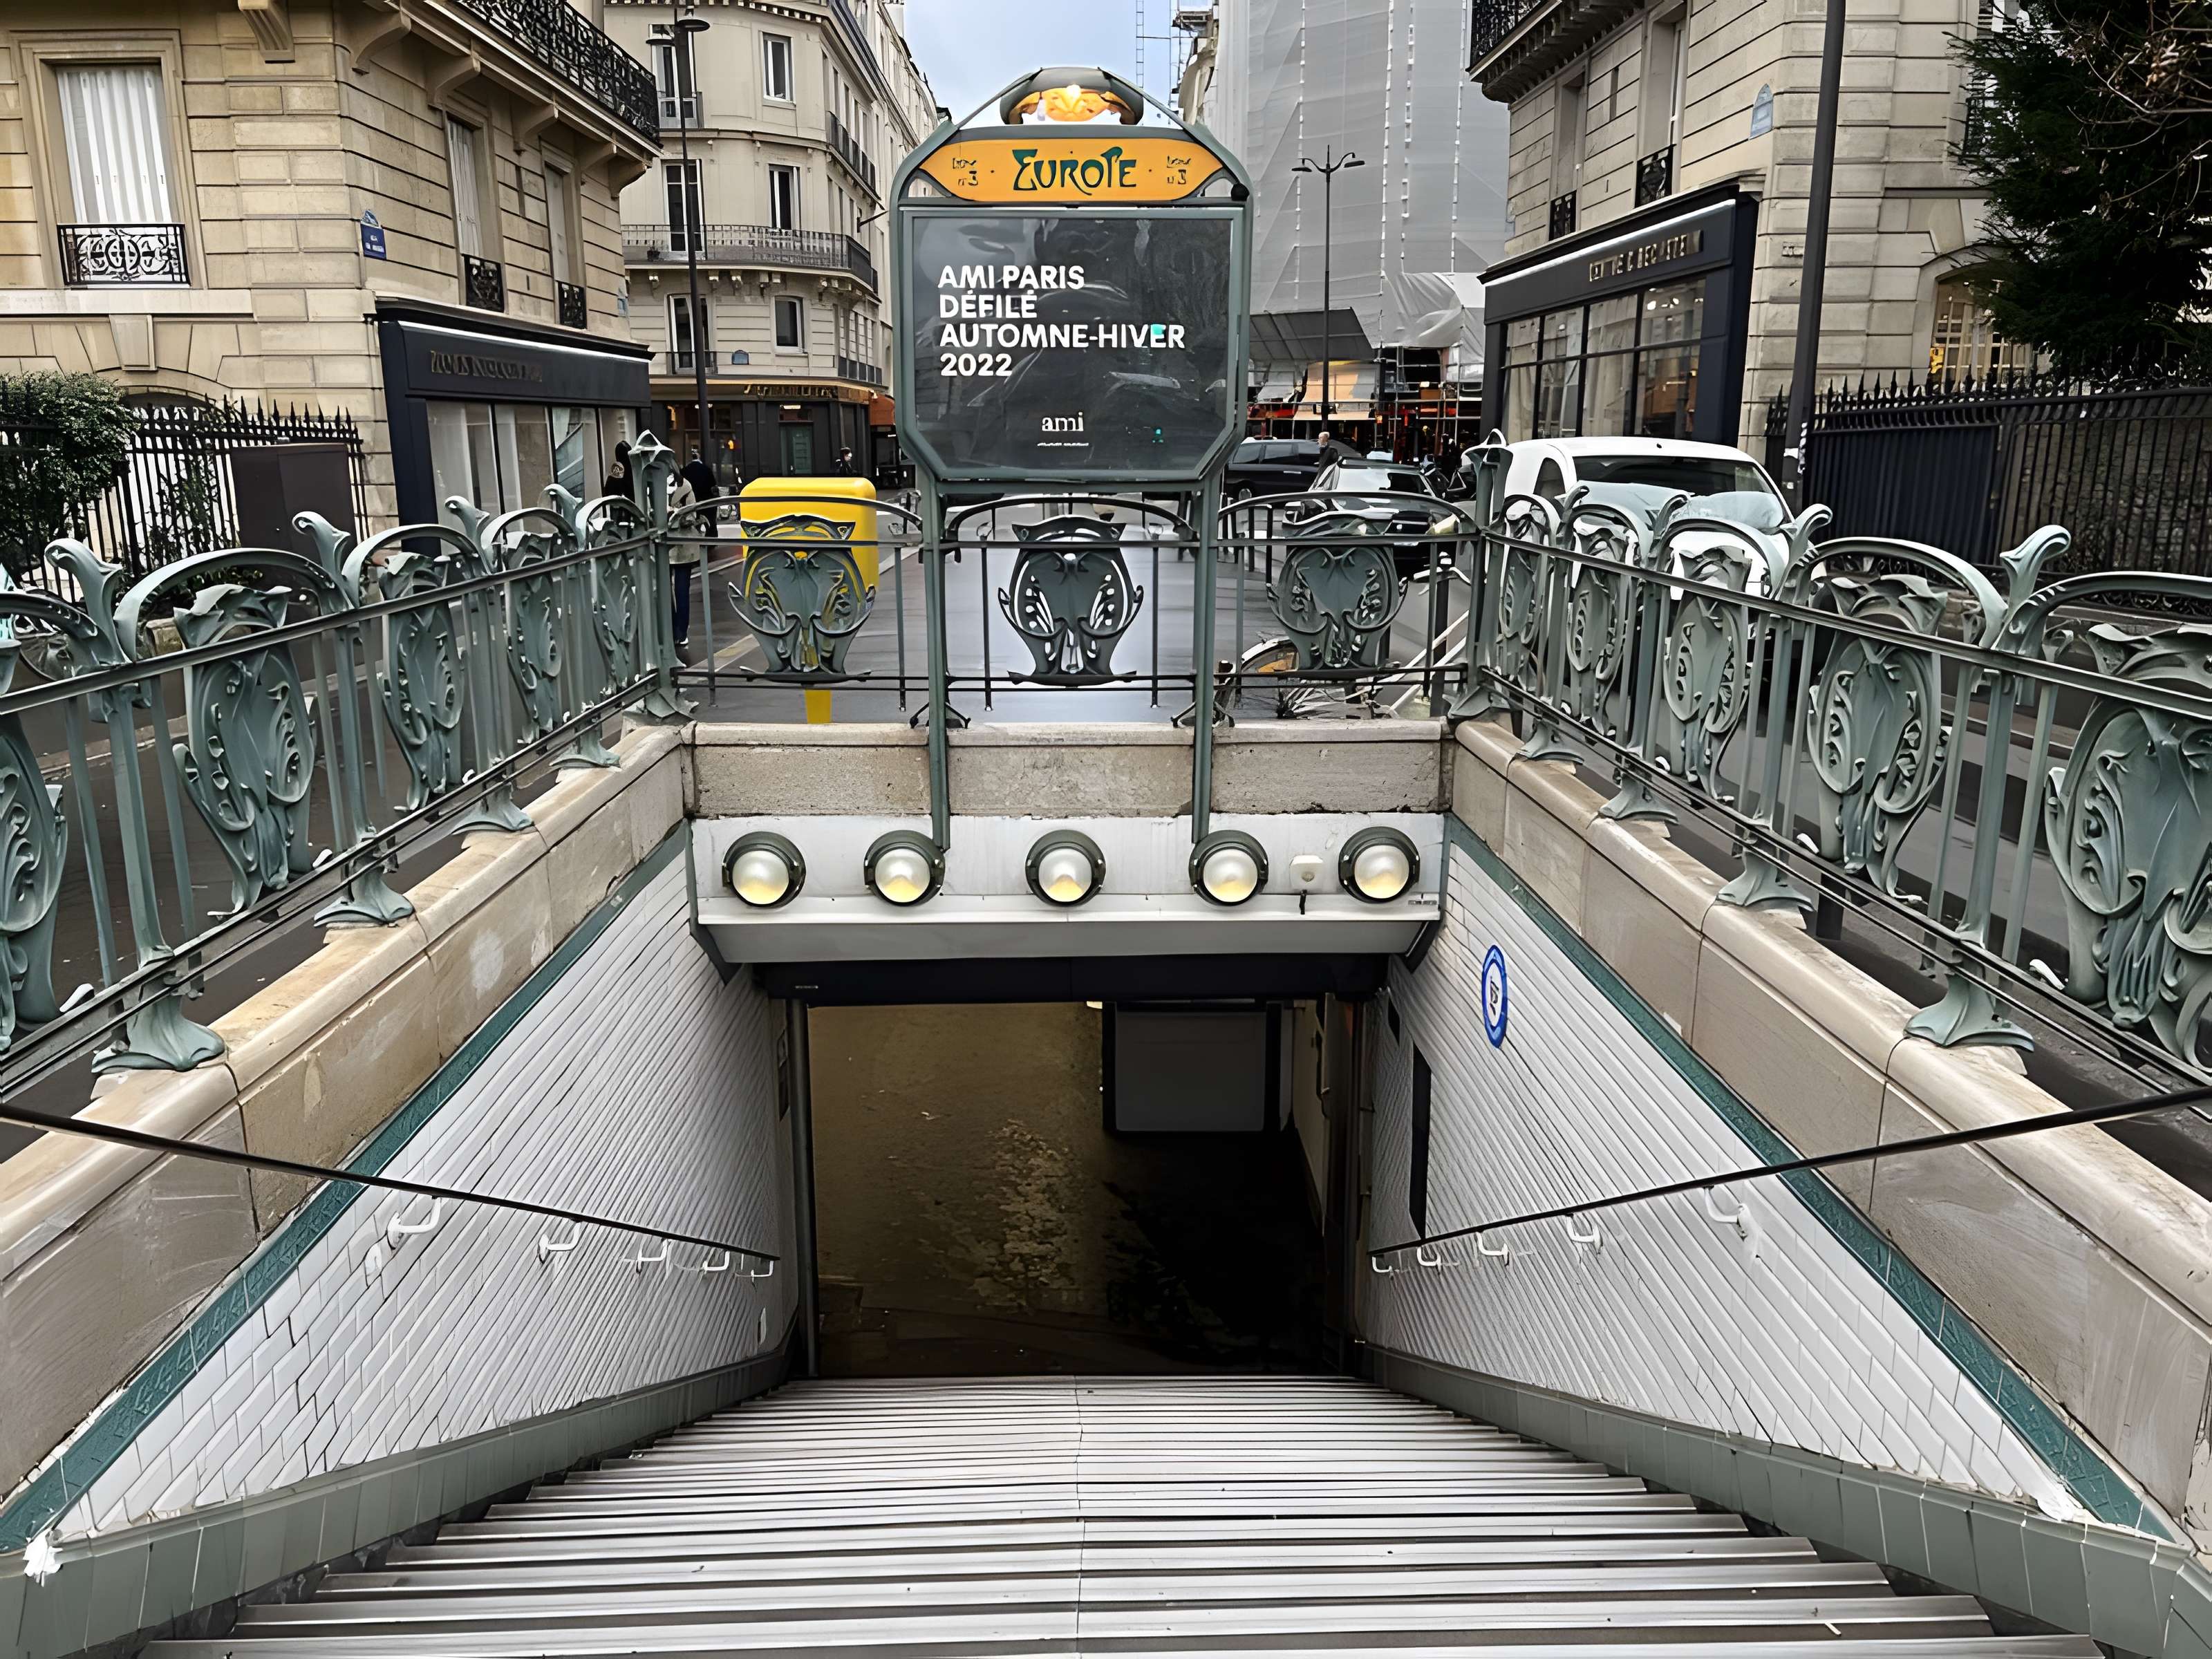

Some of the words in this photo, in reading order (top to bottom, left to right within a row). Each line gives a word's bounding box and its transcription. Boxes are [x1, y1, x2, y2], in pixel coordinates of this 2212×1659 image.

[1012, 147, 1137, 196] EUROPE
[938, 265, 995, 289] AMI
[1002, 265, 1085, 290] PARIS
[940, 289, 1038, 318] DÉFILÉ
[940, 323, 1185, 349] AUTOMNE-HIVER
[940, 353, 1013, 376] 2022
[1042, 411, 1084, 432] ami
